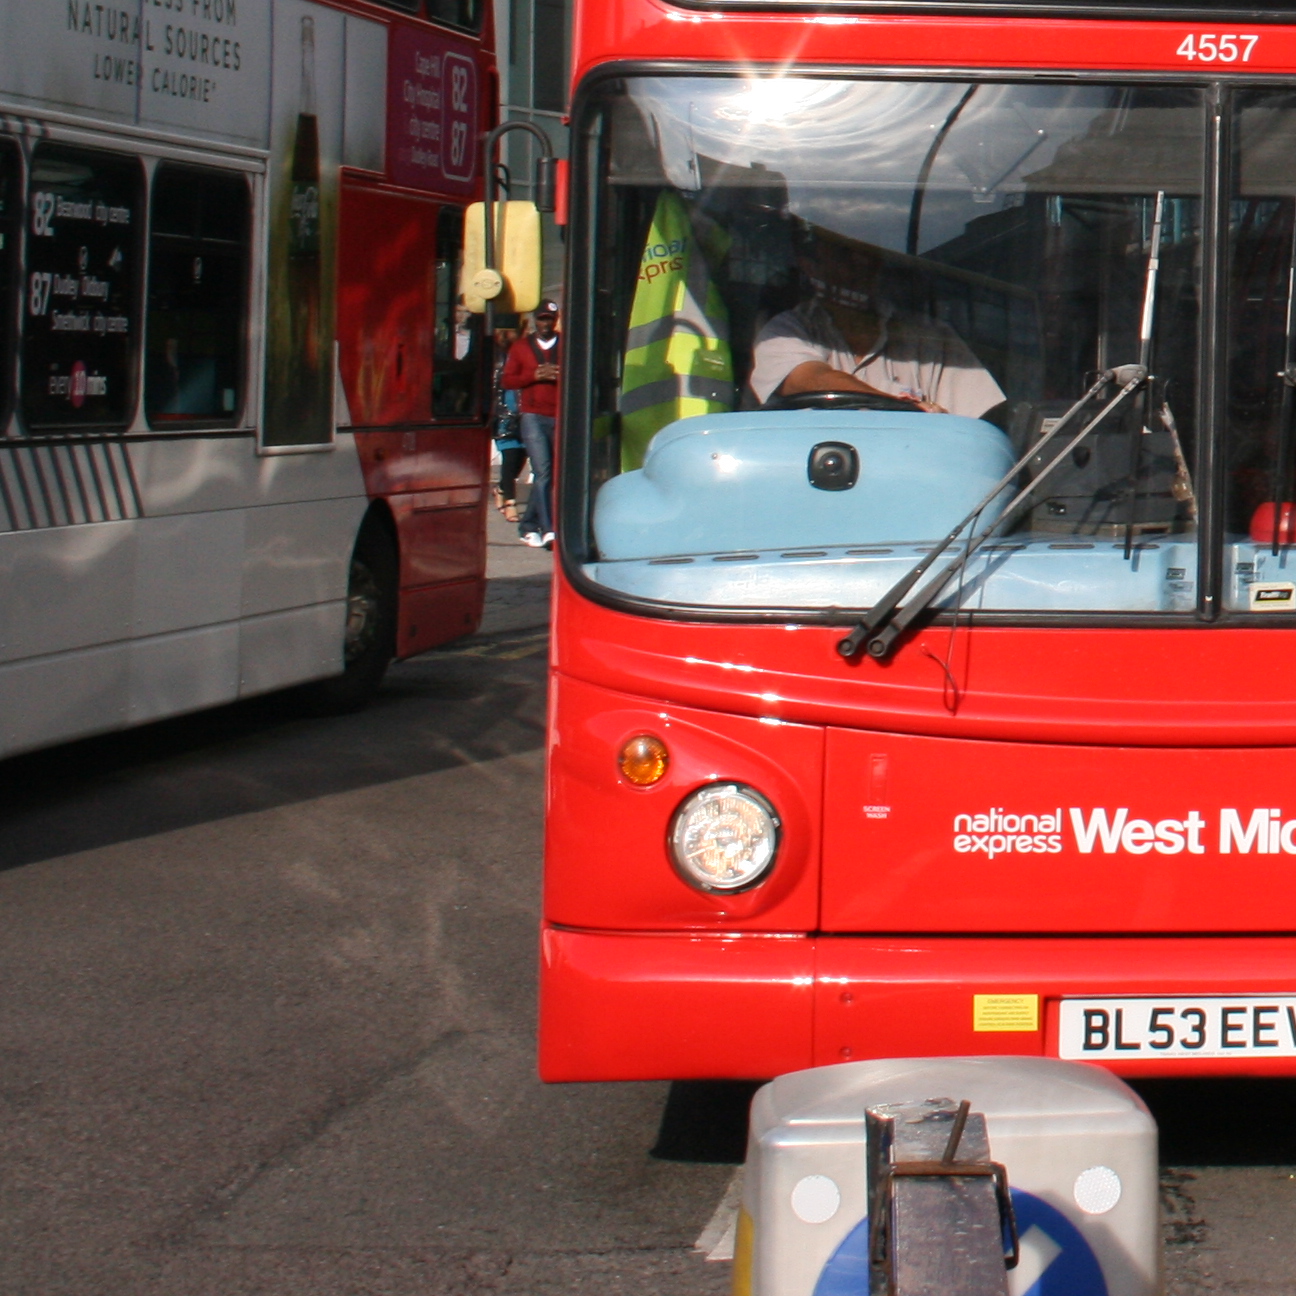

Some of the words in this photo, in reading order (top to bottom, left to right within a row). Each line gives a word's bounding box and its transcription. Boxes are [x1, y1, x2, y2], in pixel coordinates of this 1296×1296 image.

[165, 24, 242, 71] SOURCES
[1176, 33, 1259, 65] 4557
[451, 64, 468, 113] 82
[451, 119, 467, 167] 87
[32, 191, 55, 236] 82
[30, 271, 52, 316] 87
[953, 808, 1061, 833] national
[1069, 808, 1205, 854] West
[953, 831, 1062, 859] express
[1081, 1006, 1208, 1052] BL53
